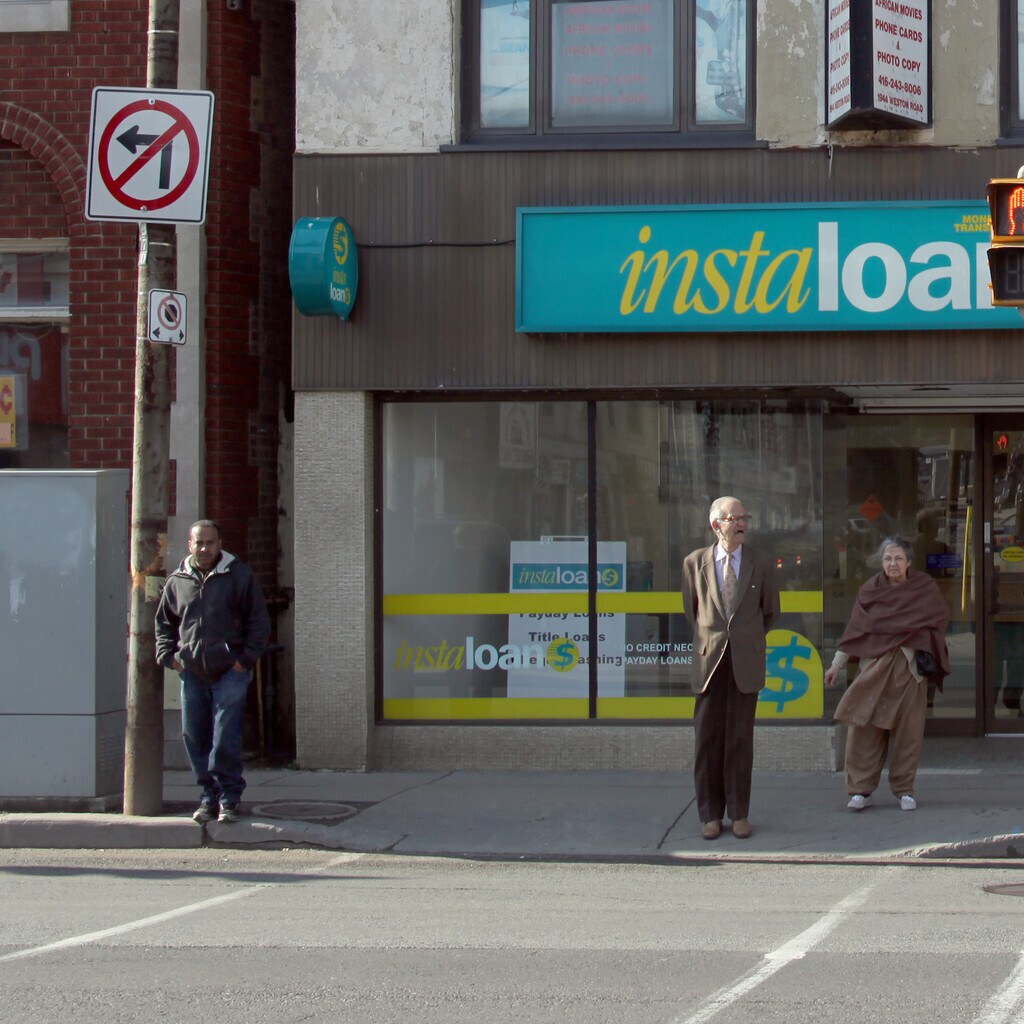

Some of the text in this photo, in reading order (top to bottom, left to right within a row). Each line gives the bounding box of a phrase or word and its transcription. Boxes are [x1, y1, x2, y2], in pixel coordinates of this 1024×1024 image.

[900, 4, 923, 21] MOVIES
[875, 18, 923, 43] PHONE CARDS
[877, 51, 921, 73] PHOTO COPY
[878, 75, 922, 96] 416-243-8006
[877, 93, 924, 113] 1944 WESTON ROAD
[528, 631, 606, 642] Title Loas
[636, 643, 671, 652] CREDIT
[660, 656, 693, 665] LOANS
